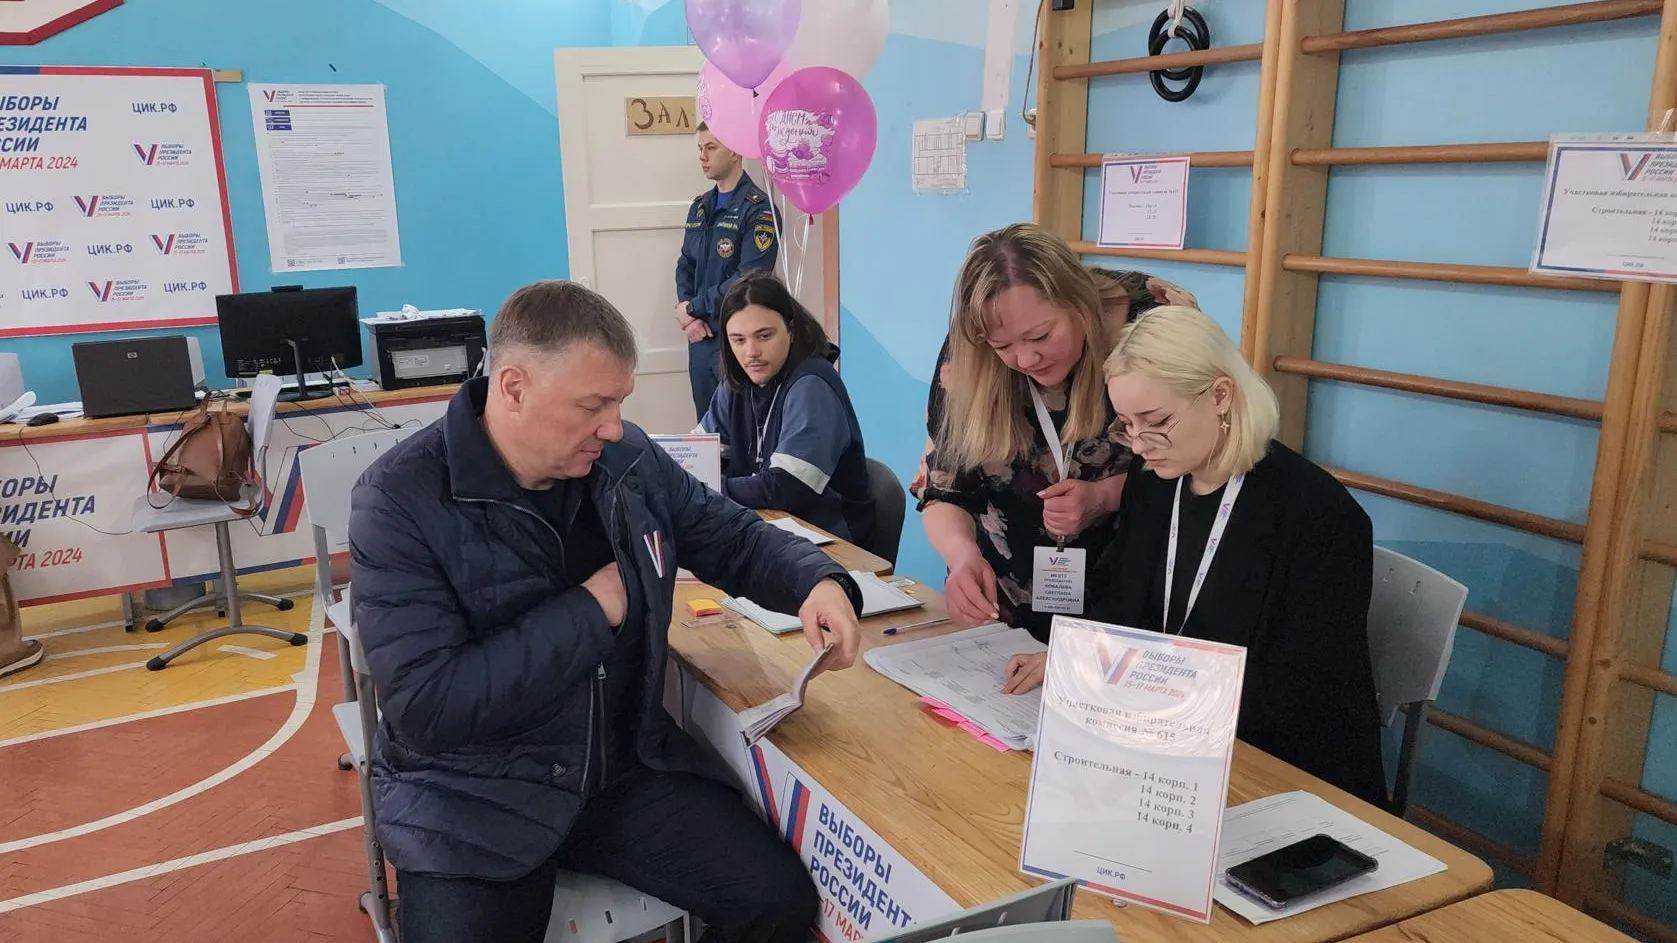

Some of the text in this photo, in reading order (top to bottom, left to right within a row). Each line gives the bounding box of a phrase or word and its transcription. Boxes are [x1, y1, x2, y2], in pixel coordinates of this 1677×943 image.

[0, 96, 60, 110] БОРЫ
[132, 103, 178, 114] ЦИК.РФ
[630, 98, 690, 130] ЗАЛ
[0, 116, 88, 134] ЕЗИДЕНТА
[0, 137, 40, 152] СИИ
[47, 156, 78, 169] 2024
[6, 201, 54, 214] ЦИК.РФ
[151, 198, 195, 211] ЦИК.РФ
[87, 244, 133, 256] ЦИК.РФ
[22, 288, 69, 301] ЦИК.РФ
[164, 281, 208, 294] ЦИК.РФ
[0, 474, 58, 498] ОРЫ
[0, 495, 95, 526] ИДЕНТА
[40, 548, 82, 568] 2024
[1142, 650, 1186, 664] ВЫБОРЫ
[1129, 671, 1168, 685] РОССИИ
[1054, 750, 1132, 777] Строительная
[1143, 772, 1154, 782] 14
[1158, 776, 1189, 790] корп.
[1193, 783, 1198, 792] 1
[1141, 784, 1196, 806] 14 корп. 2
[1139, 798, 1194, 820] 14 корп. 3
[1137, 812, 1192, 834] 14 корп. 4
[819, 802, 892, 884] ВЫБОРЫ
[814, 830, 914, 928] ПРЕЗИДЕНТ
[1096, 866, 1126, 880] ЦИК.РФ
[810, 856, 872, 930] РОССИИ
[836, 911, 864, 941] МАР
